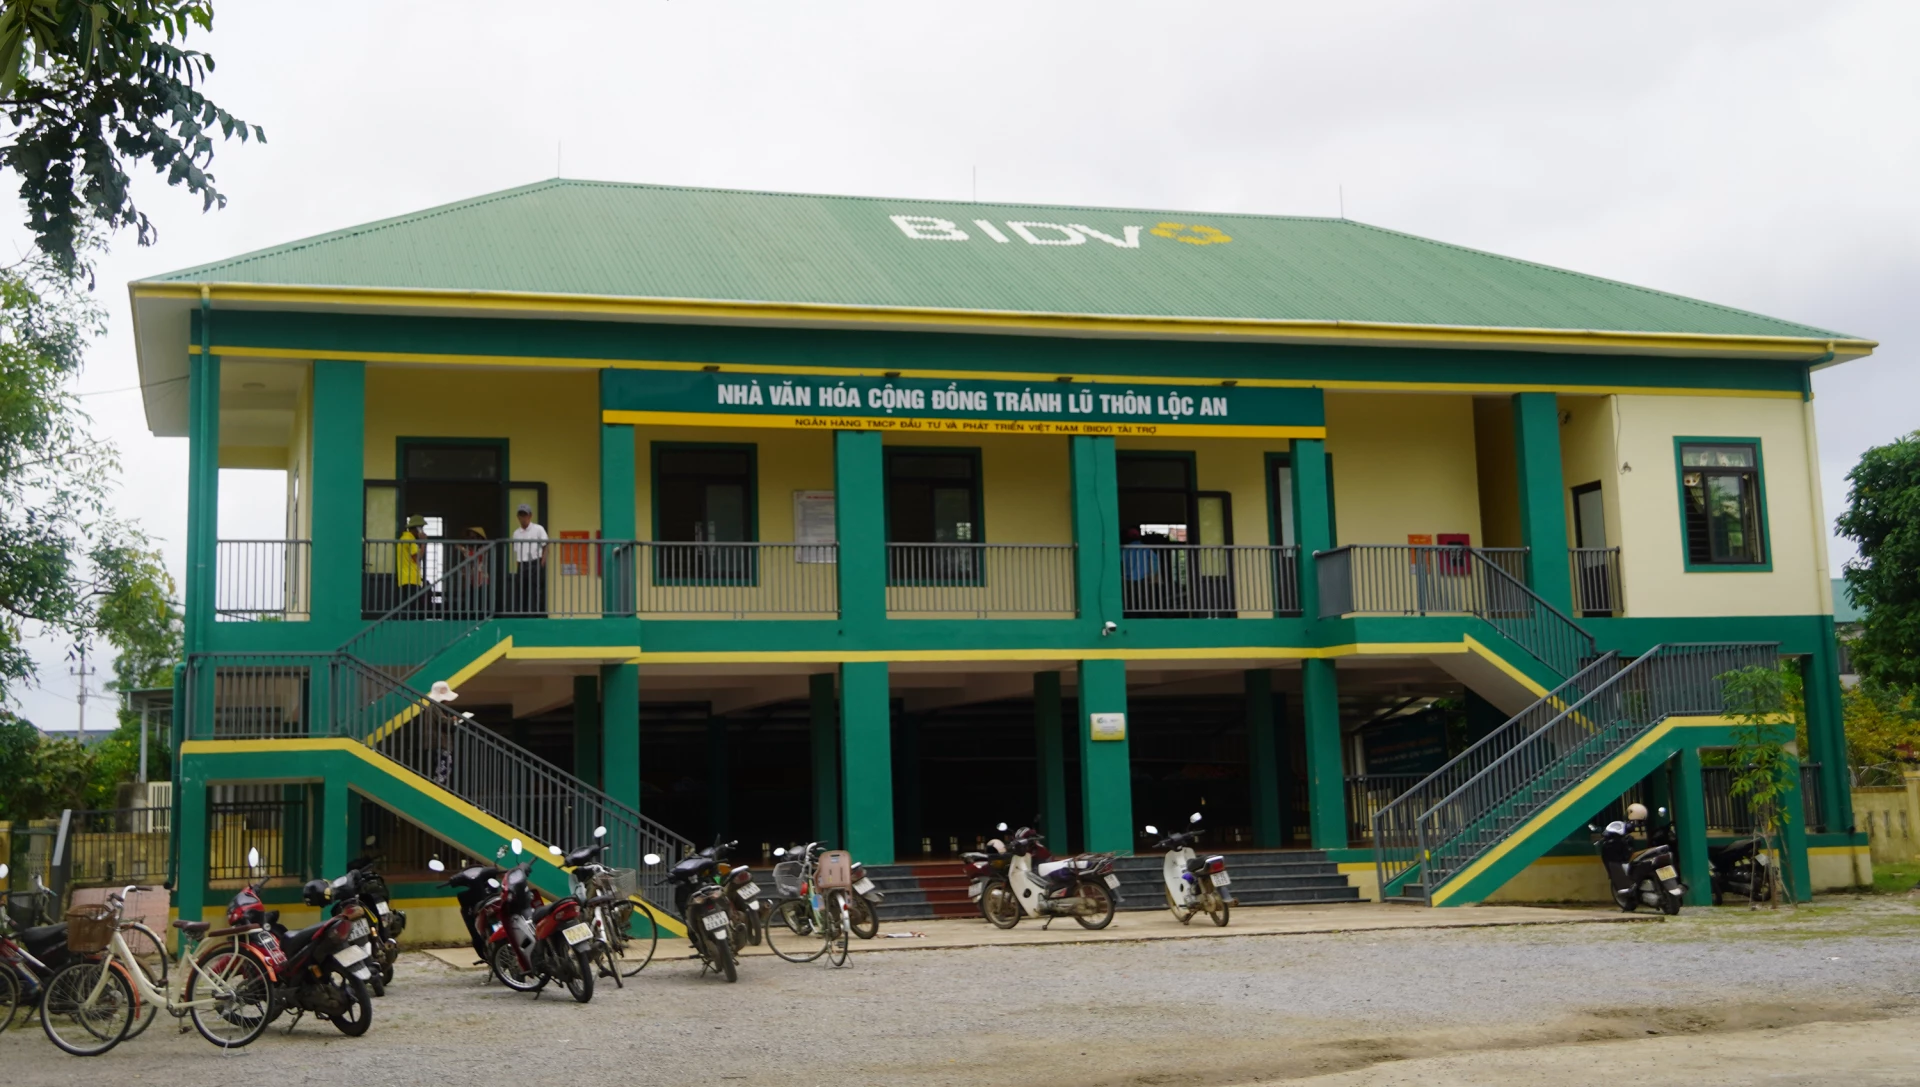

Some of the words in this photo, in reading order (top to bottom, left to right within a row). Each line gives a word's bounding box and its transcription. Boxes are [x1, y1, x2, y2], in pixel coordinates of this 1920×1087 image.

[889, 214, 1143, 249] BIDV
[717, 380, 764, 405] NHÀ
[768, 381, 811, 406] VĂN
[818, 382, 862, 407] HÓA
[867, 384, 925, 413] CỘNG
[931, 382, 988, 411] ĐỒNG
[993, 388, 1062, 413] TRÁNH
[1068, 389, 1094, 414] LŨ
[1099, 390, 1152, 415] THÔN
[1157, 392, 1194, 420] LỘC
[1199, 397, 1228, 416] AN
[794, 417, 827, 427] NGÂN
[830, 418, 862, 428] HÀNG
[866, 420, 896, 428] TMCP
[900, 418, 922, 429] ĐẦU
[927, 420, 942, 429] TƯ
[945, 419, 958, 430] VÀ
[963, 420, 989, 430] PHÁT
[994, 420, 1024, 431] TRIỂN
[1028, 422, 1051, 433] VIỆT
[1055, 424, 1079, 432] NAM
[1117, 424, 1133, 433] TÀI
[1135, 425, 1157, 435] TRỢ
